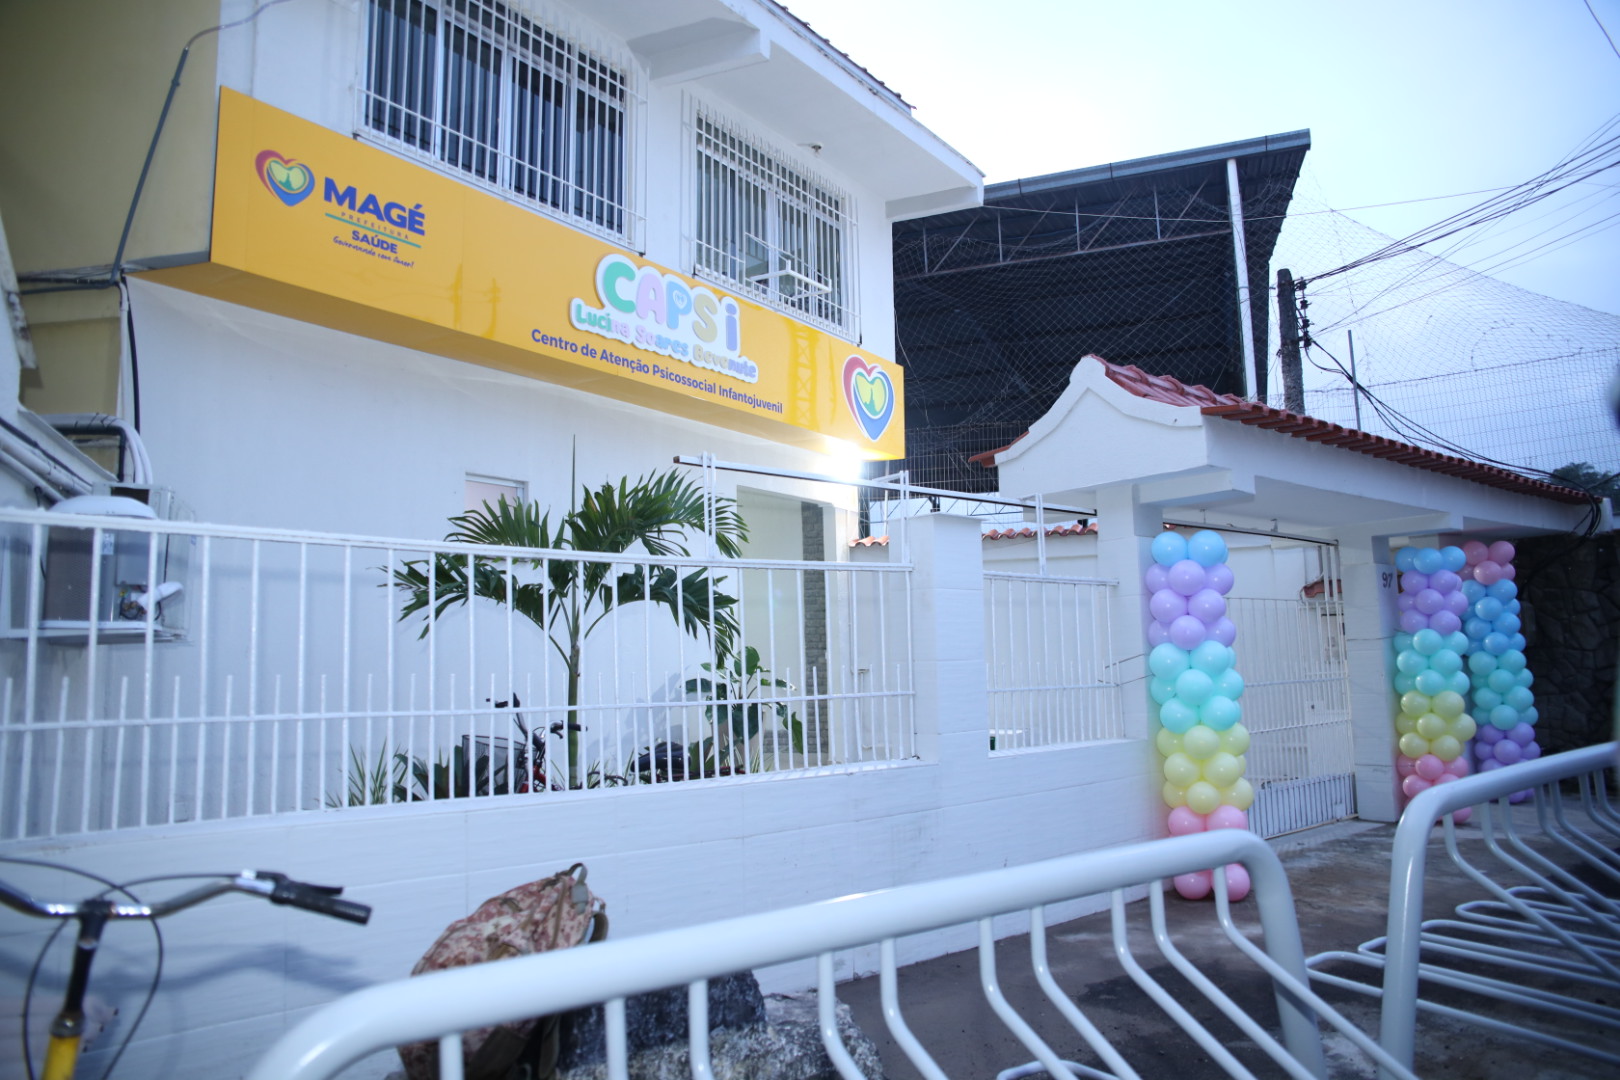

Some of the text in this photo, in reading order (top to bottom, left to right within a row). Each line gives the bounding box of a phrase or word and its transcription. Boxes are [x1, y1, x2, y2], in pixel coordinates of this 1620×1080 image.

[323, 175, 426, 236] MAGÉ
[341, 211, 409, 240] PREFEITURA
[351, 229, 398, 254] SAÚDE
[576, 303, 630, 339] Lucina
[635, 325, 689, 357] Soares
[531, 328, 783, 414] Centro de Atenção Psicossocial Infantojuvenil
[1382, 572, 1393, 589] 97
